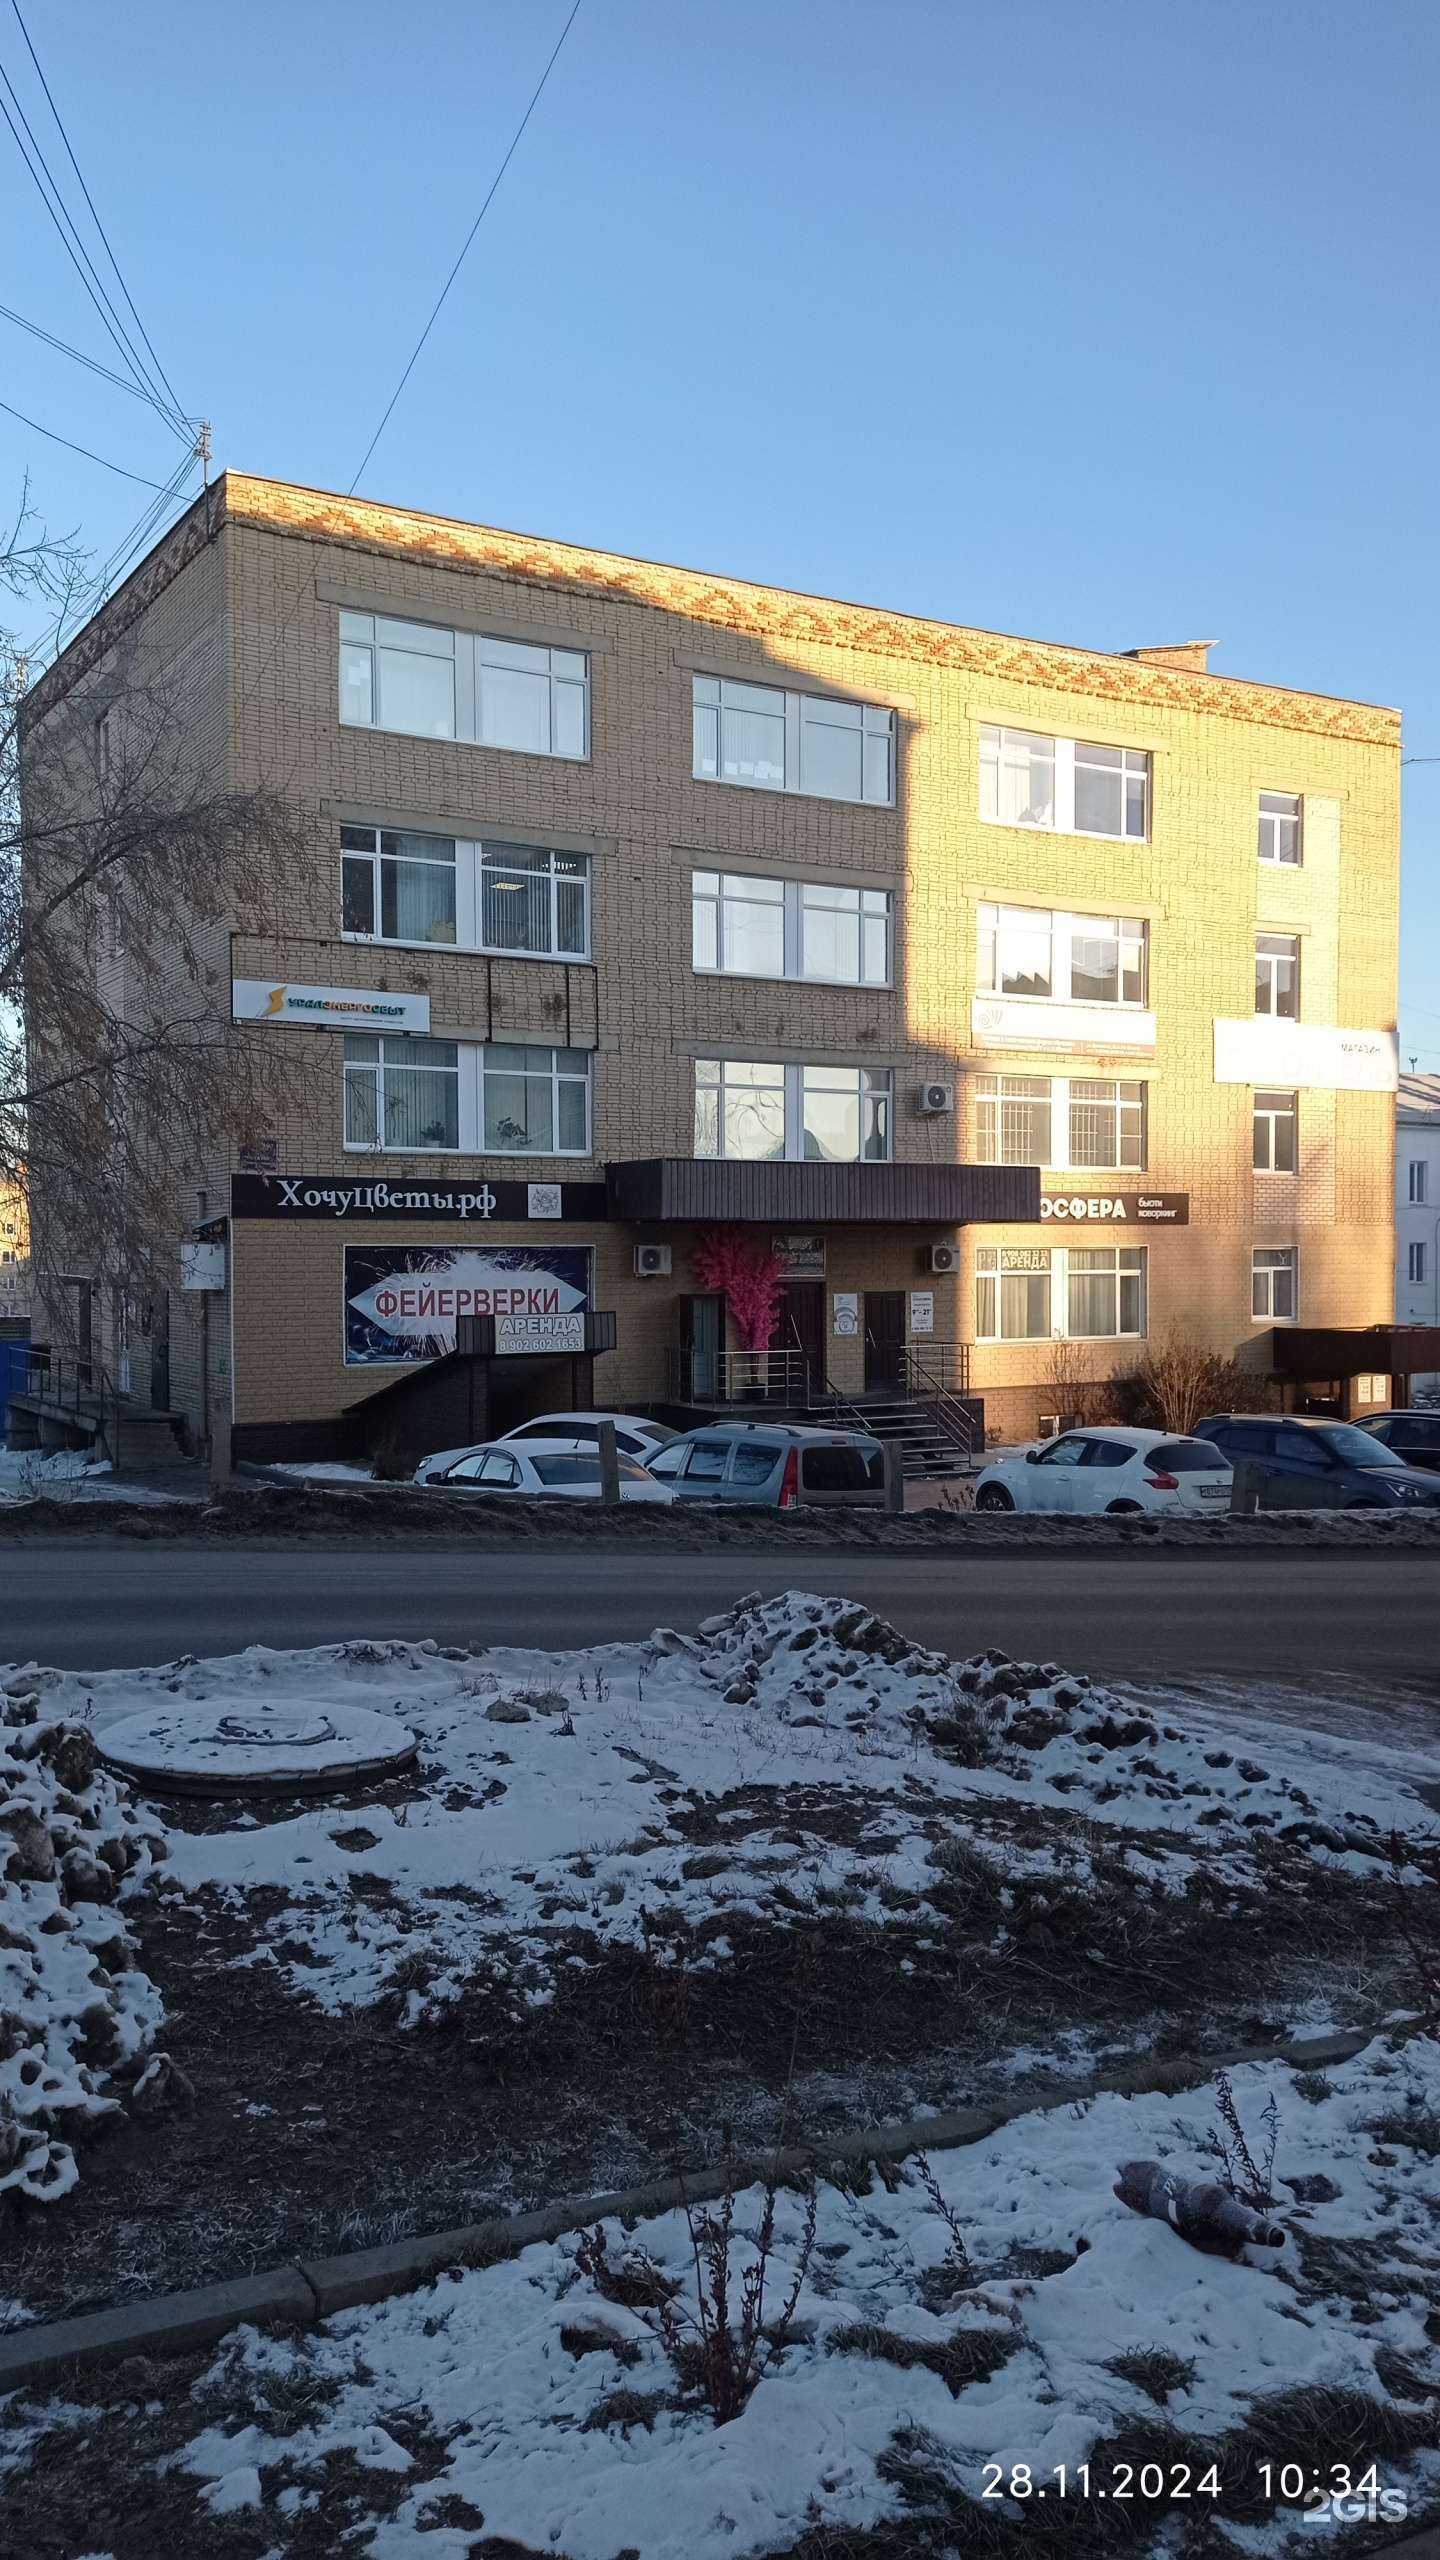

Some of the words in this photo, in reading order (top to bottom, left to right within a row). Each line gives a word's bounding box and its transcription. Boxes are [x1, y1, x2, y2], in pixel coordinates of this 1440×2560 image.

[276, 1179, 497, 1220] ХочуЦветы.рф
[1002, 1256, 1048, 1270] АРЕНДА
[375, 1281, 560, 1318] ФЕЙЕРВЕРКИ
[499, 1317, 582, 1336] АРЕНДА
[499, 1340, 506, 1352] 8
[510, 1339, 530, 1352] 902
[532, 1338, 553, 1351] 602
